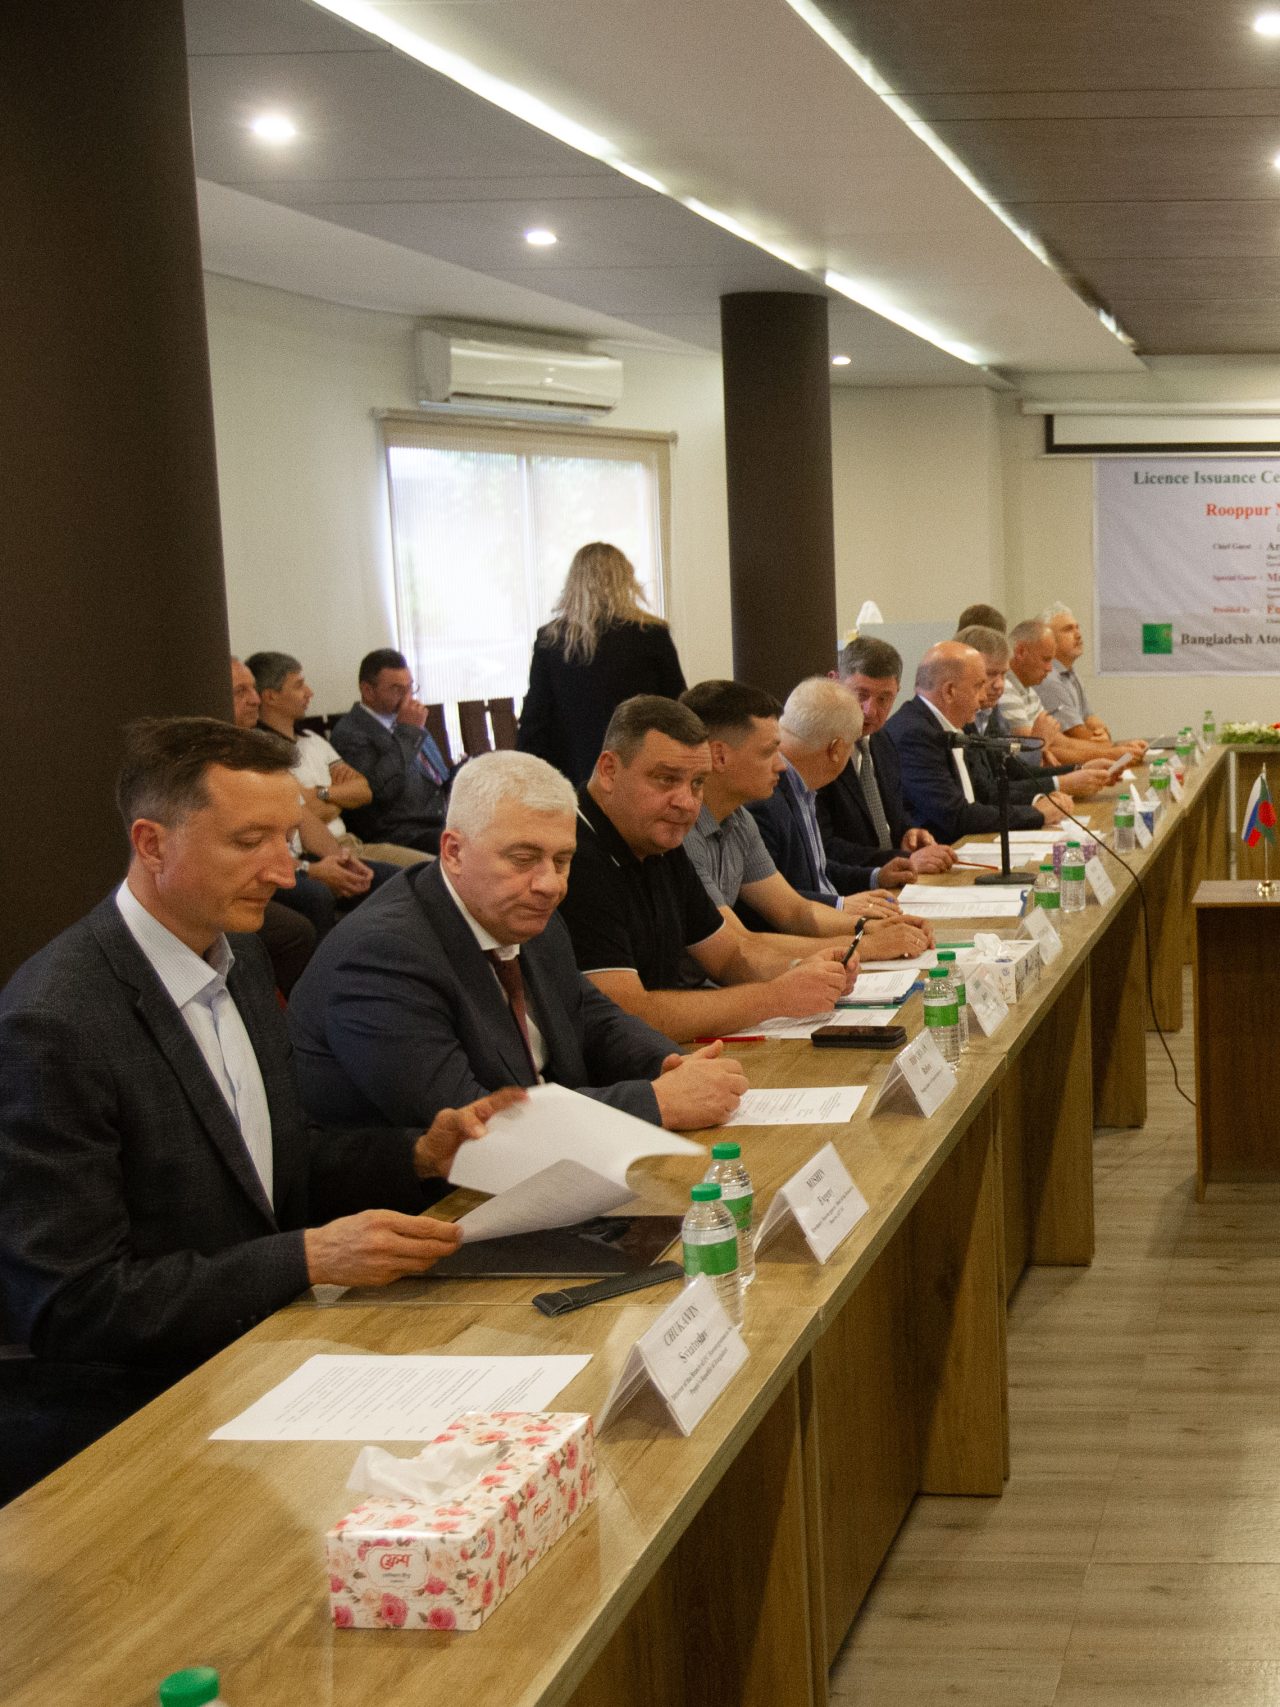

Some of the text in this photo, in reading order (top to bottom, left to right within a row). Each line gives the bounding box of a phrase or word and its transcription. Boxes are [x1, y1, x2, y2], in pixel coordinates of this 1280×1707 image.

[1133, 471, 1190, 485] Licence
[1194, 471, 1257, 485] Issuance
[1205, 503, 1271, 519] Rooppur
[1180, 632, 1253, 647] Bangladesh
